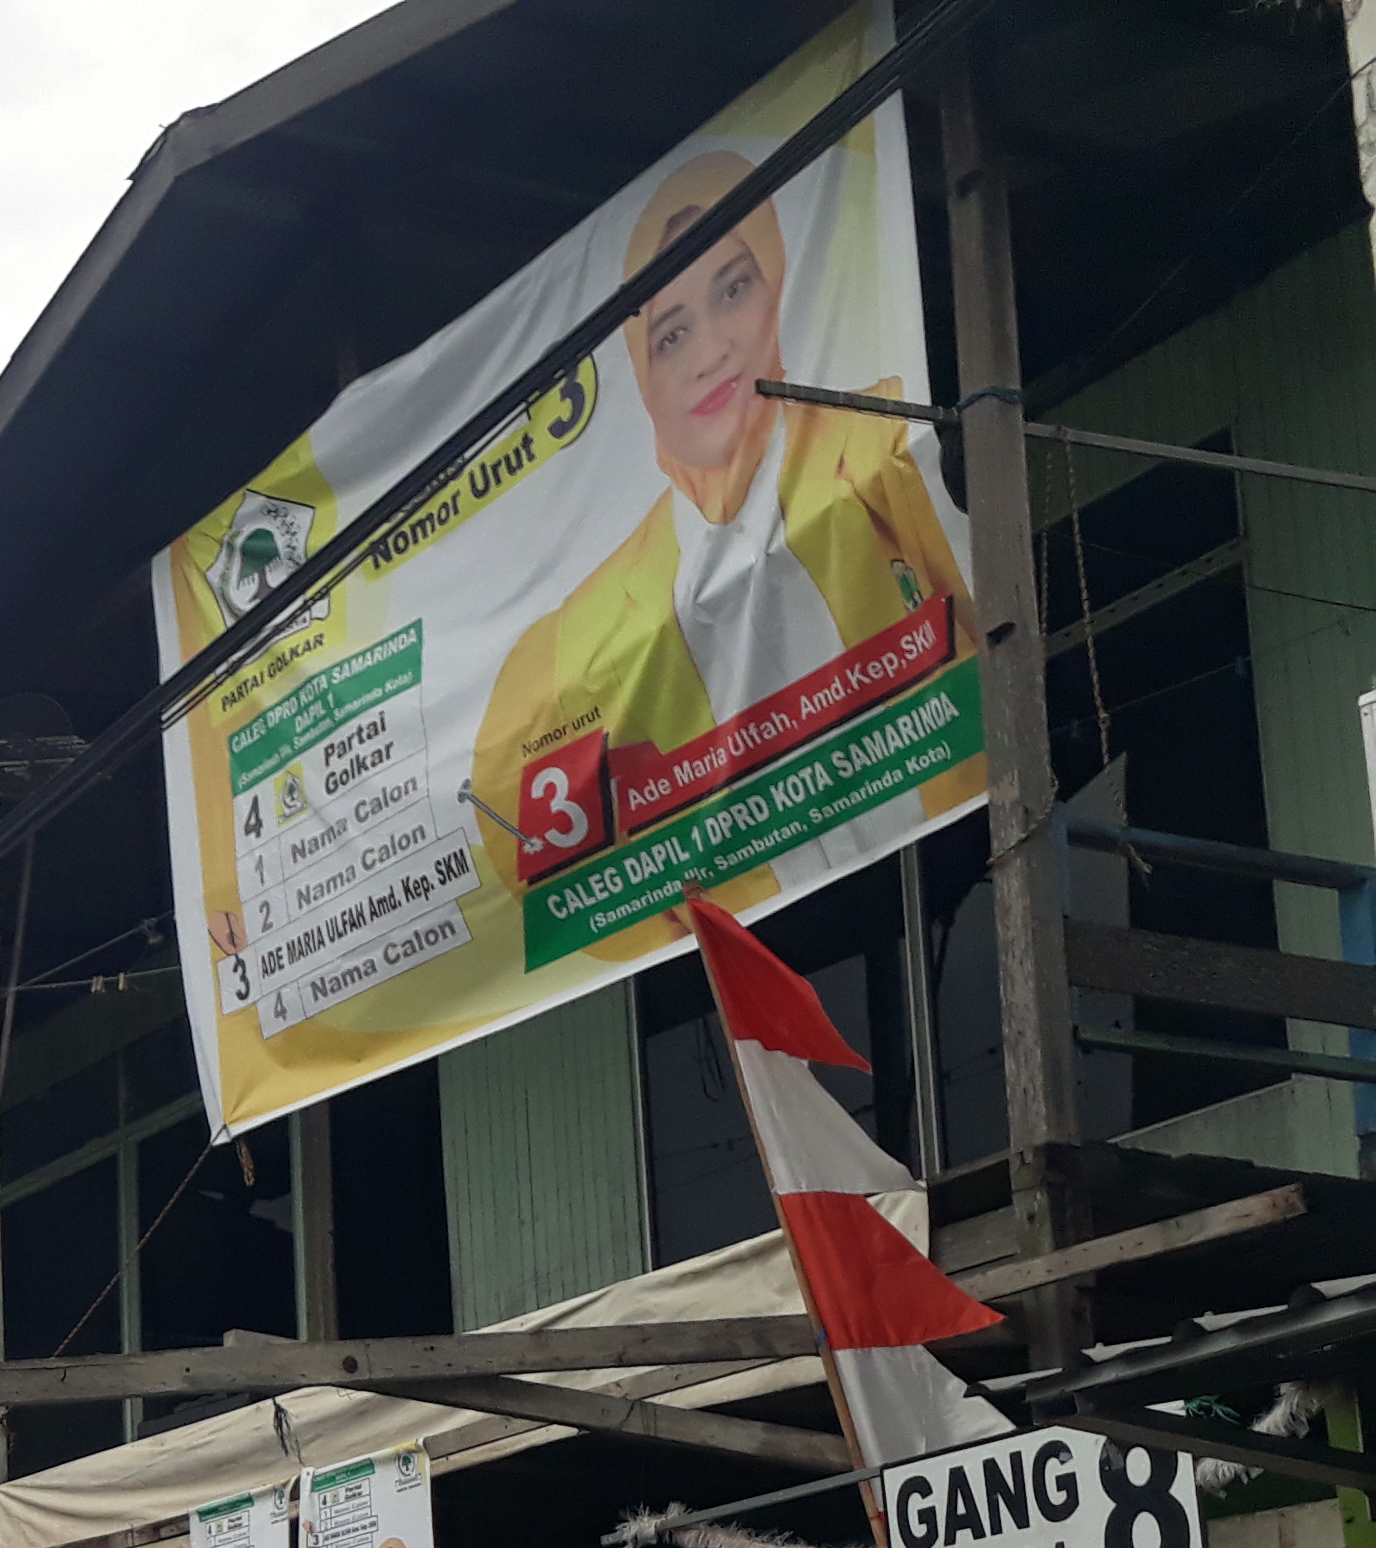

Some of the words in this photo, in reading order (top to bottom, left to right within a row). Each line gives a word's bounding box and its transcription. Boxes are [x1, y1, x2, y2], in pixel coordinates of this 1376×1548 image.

[367, 489, 461, 570] Nomor
[468, 433, 537, 499] Urut
[221, 670, 265, 712] PARTAI
[267, 633, 325, 680] GOLKAR
[299, 674, 329, 706] KOTA
[331, 627, 417, 685] SAMARINDA
[324, 711, 387, 767] Partai
[521, 721, 571, 758] Nomor
[572, 705, 602, 732] urut
[627, 777, 672, 811] Ade
[672, 745, 728, 792] Maria
[727, 710, 798, 758] Ulfah,
[243, 794, 264, 838] 4
[325, 739, 394, 796] Golkar
[254, 855, 265, 887] 1
[291, 815, 348, 864] Nama
[353, 775, 419, 824] Calon
[530, 766, 588, 849] 3
[546, 863, 624, 920] CALEG
[623, 836, 691, 887] DAPIL
[690, 825, 705, 854] 1
[704, 794, 771, 845] DPRD
[769, 761, 835, 812] KOTA
[830, 690, 960, 778] SAMARINDA
[589, 880, 684, 934] (Samarinda
[713, 820, 808, 871] Sambutan,
[808, 767, 904, 824] Samarinda
[905, 740, 952, 775] Kota)
[232, 956, 250, 1001] 3
[260, 952, 285, 980] ADE
[287, 925, 326, 966] MARIA
[327, 900, 368, 942] ULFAH
[368, 885, 402, 921] Amd.
[401, 874, 436, 904] Kep.
[434, 848, 470, 886] SKM
[259, 899, 274, 933] 2
[297, 861, 357, 911] Nama
[360, 823, 427, 872] Calon
[273, 991, 288, 1021] 4
[309, 956, 378, 1003] Nama
[382, 919, 457, 966] Calon
